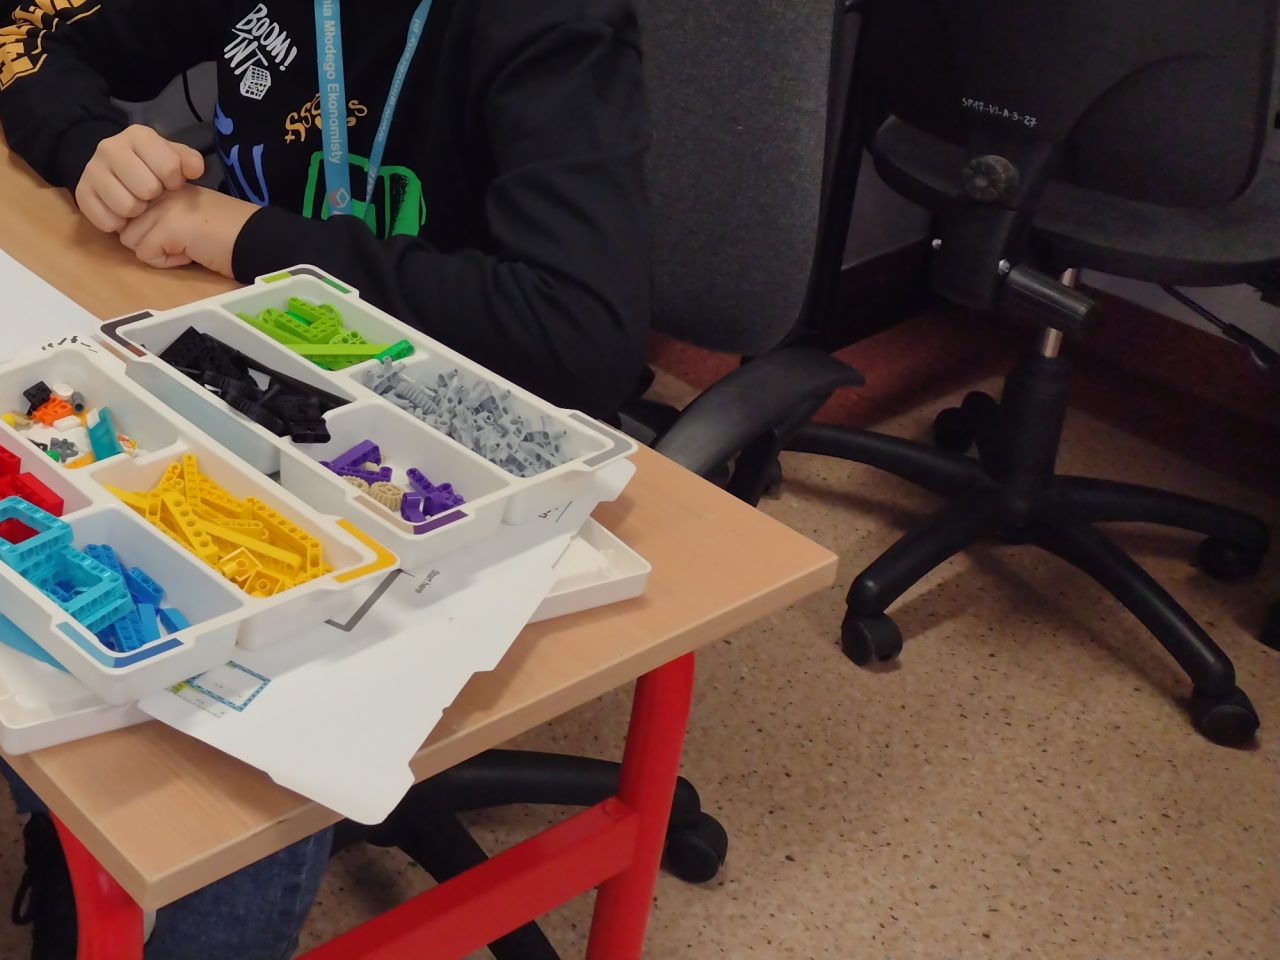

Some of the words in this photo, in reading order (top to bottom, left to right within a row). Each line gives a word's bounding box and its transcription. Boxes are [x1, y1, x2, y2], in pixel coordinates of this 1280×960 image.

[223, 28, 269, 75] TNT
[235, 3, 298, 71] BOOM!
[323, 20, 336, 80] Młodego
[327, 83, 343, 164] Ekonomisty
